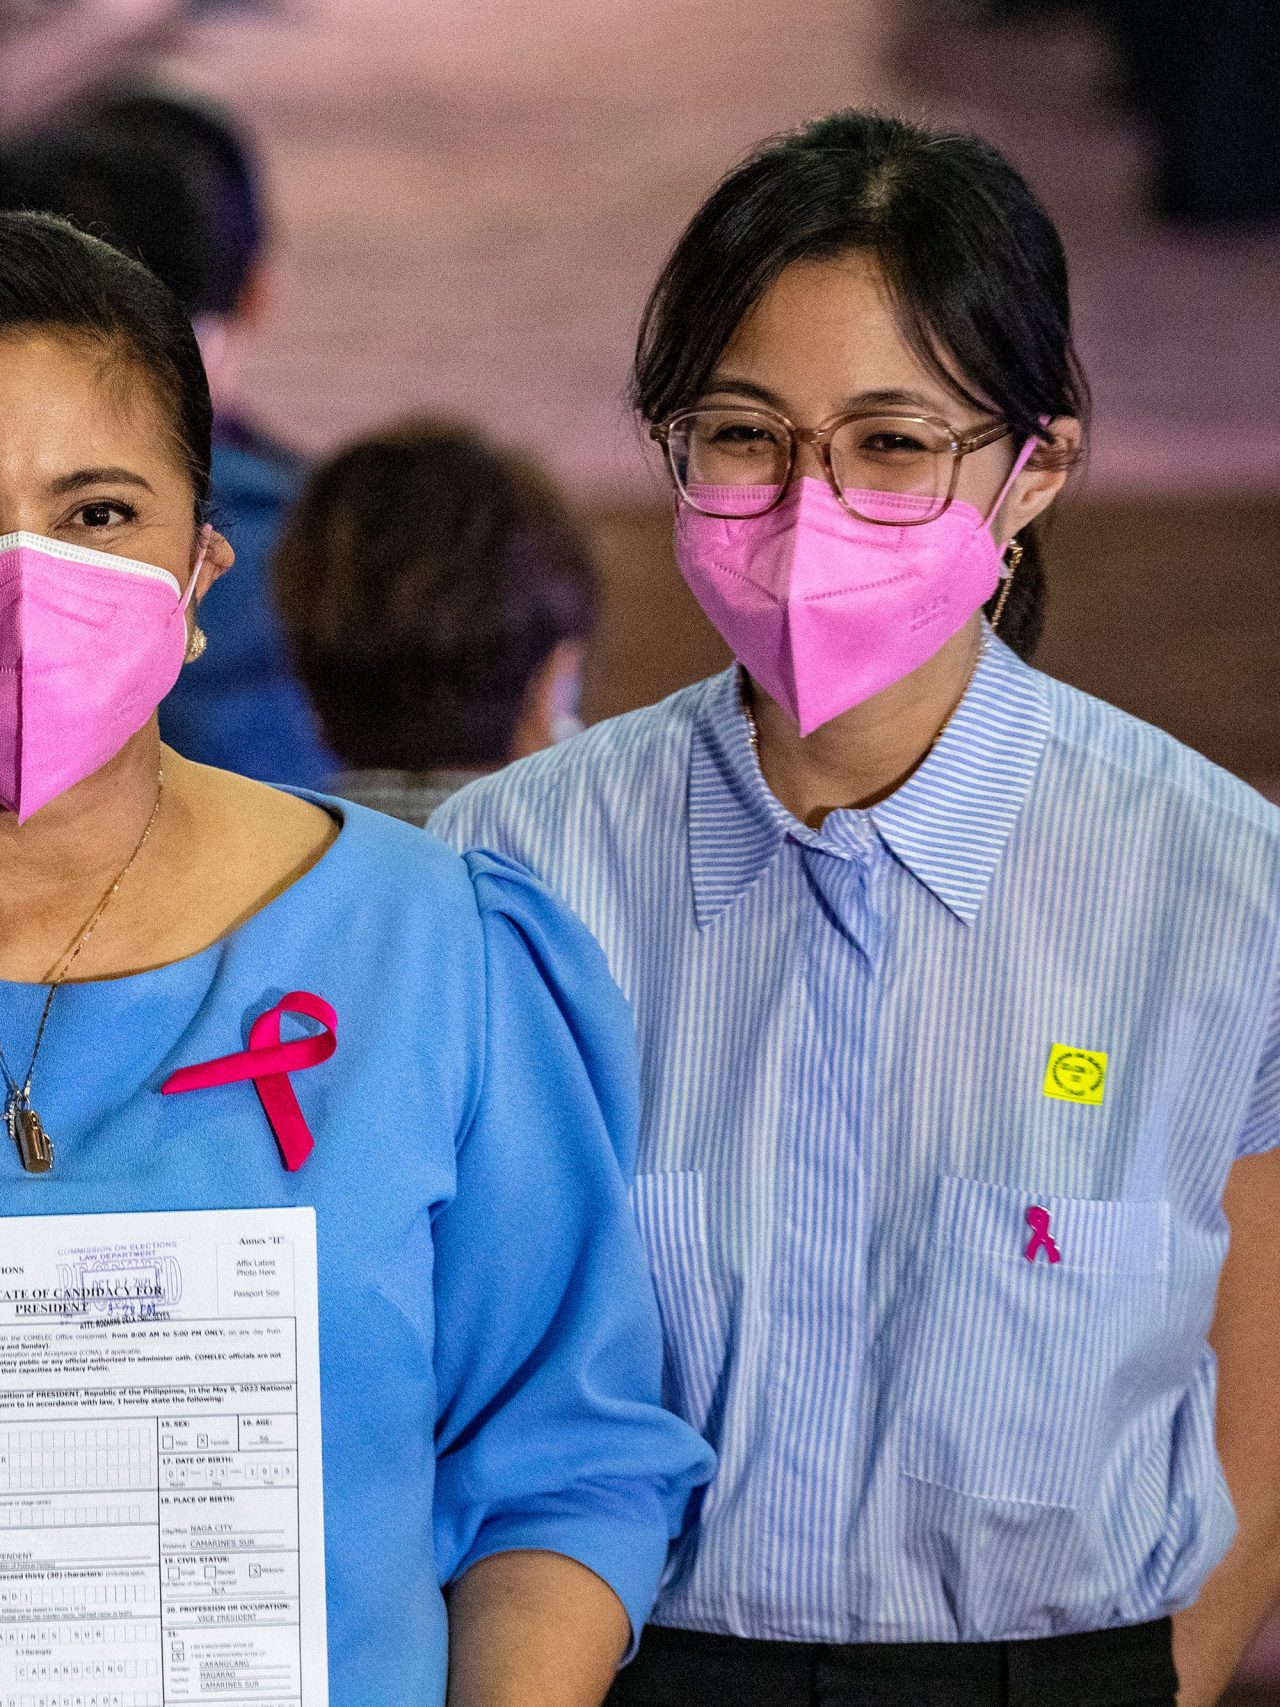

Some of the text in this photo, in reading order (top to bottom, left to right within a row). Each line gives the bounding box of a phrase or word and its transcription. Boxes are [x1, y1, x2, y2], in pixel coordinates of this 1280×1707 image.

[239, 1236, 284, 1245] Annex "H"
[57, 1247, 112, 1256] COMMISSION
[130, 1241, 177, 1250] ELECTIONS
[100, 1250, 157, 1259] DEPARTMENT
[236, 1259, 276, 1268] Affix Latest
[237, 1269, 276, 1277] Photo Here
[32, 1288, 49, 1299] OF
[53, 1286, 129, 1299] CANDIDACY
[134, 1285, 164, 1297] FOR
[233, 1289, 280, 1300] Passport Size
[15, 1302, 89, 1314] PRESIDENT
[36, 1391, 82, 1399] PRESIDENT,
[84, 1390, 117, 1398] Republic
[212, 1387, 228, 1395] May
[36, 1400, 79, 1408] accordance
[123, 1398, 149, 1407] hereby
[196, 1457, 205, 1465] OF
[173, 1496, 196, 1504] PLACE
[198, 1496, 207, 1504] OF
[190, 1524, 212, 1532] NAGA
[215, 1523, 232, 1531] CITY
[190, 1538, 236, 1548] CAMARINES
[239, 1538, 255, 1546] SUR
[25, 1573, 45, 1582] thirty
[179, 1604, 226, 1613] PROFESSION
[228, 1604, 238, 1612] OR
[198, 1614, 256, 1623] VICE PRESIDENT
